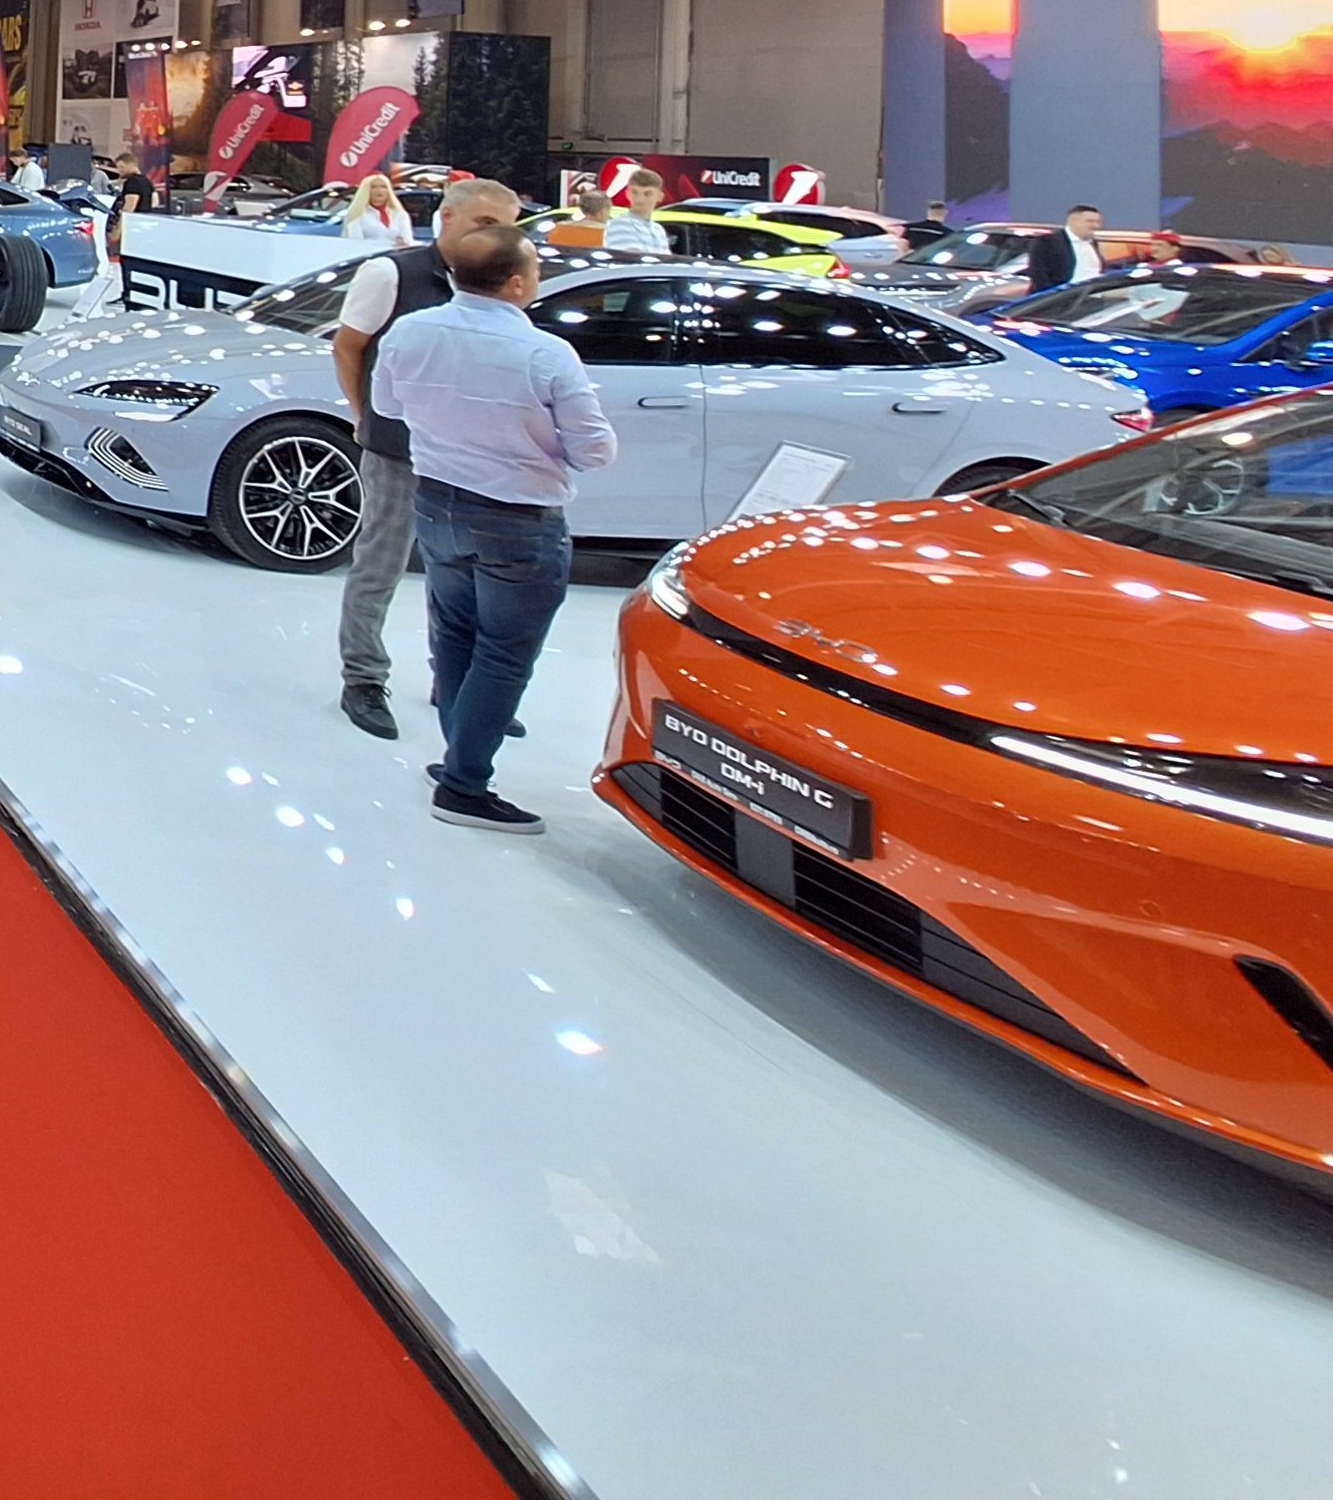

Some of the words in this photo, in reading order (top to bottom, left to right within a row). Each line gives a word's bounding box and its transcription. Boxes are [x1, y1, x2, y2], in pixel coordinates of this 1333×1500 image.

[226, 103, 265, 149] UniCredit
[349, 102, 400, 155] UniCredit
[712, 170, 761, 187] UniCredit
[665, 714, 707, 746] BYD
[711, 737, 810, 798] DOLPHIN
[814, 789, 834, 809] G
[721, 762, 765, 796] DM-i
